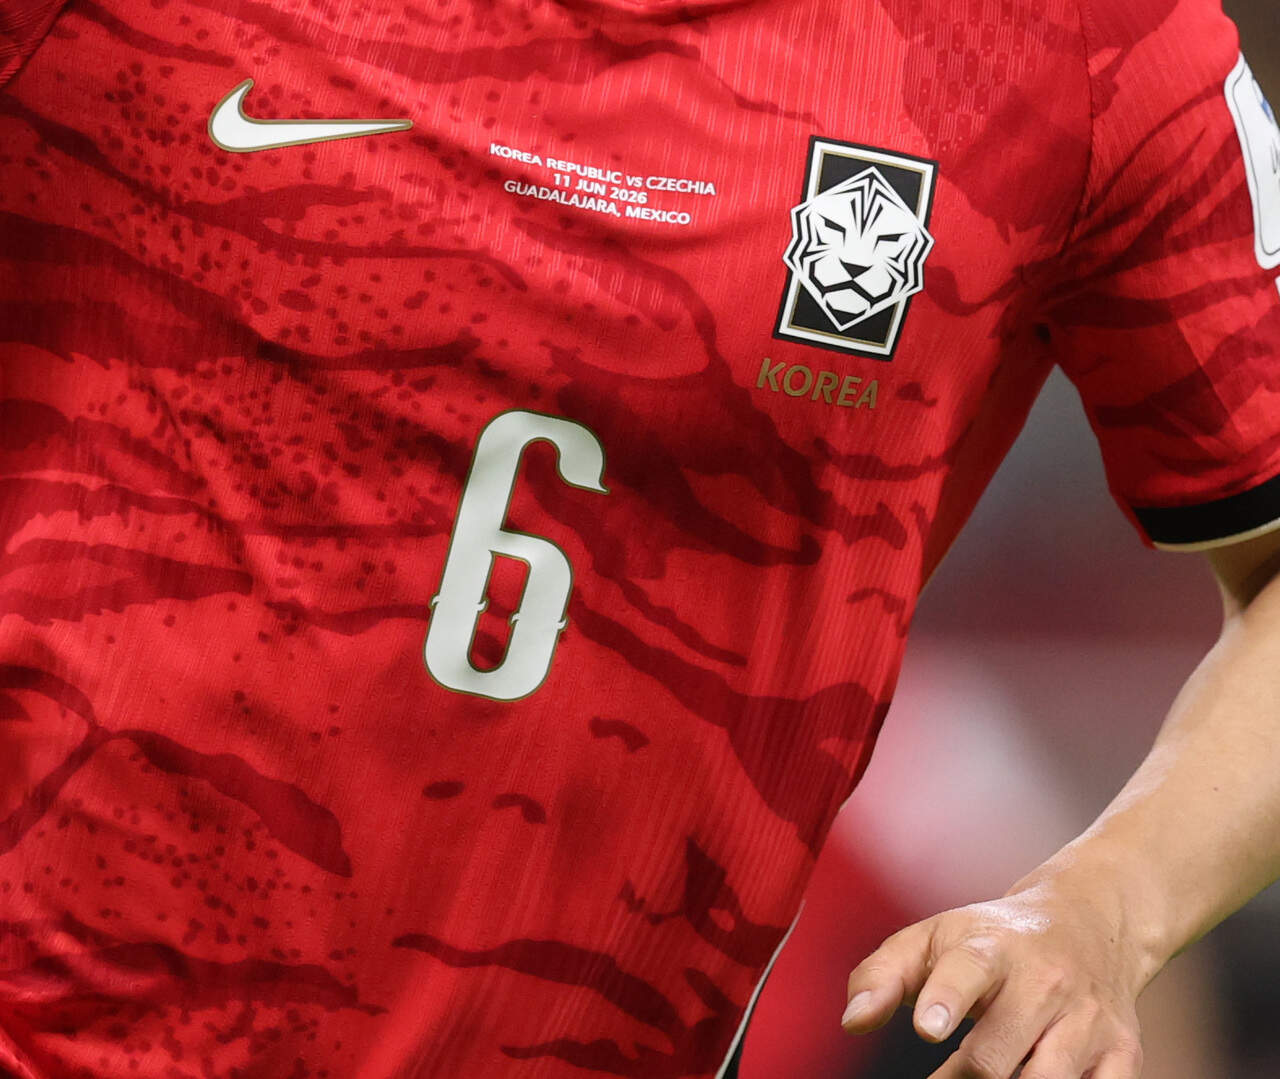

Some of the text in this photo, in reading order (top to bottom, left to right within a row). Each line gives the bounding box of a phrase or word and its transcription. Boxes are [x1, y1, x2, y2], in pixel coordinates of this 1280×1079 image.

[490, 143, 542, 166] KOREA
[546, 158, 622, 184] REPUBLIC
[646, 176, 716, 195] CZECHIA
[554, 173, 648, 204] 11 JUN 2026
[504, 180, 691, 225] GUADALAJARA, MEXICO
[756, 358, 879, 408] KOREA
[423, 408, 610, 702] 6
